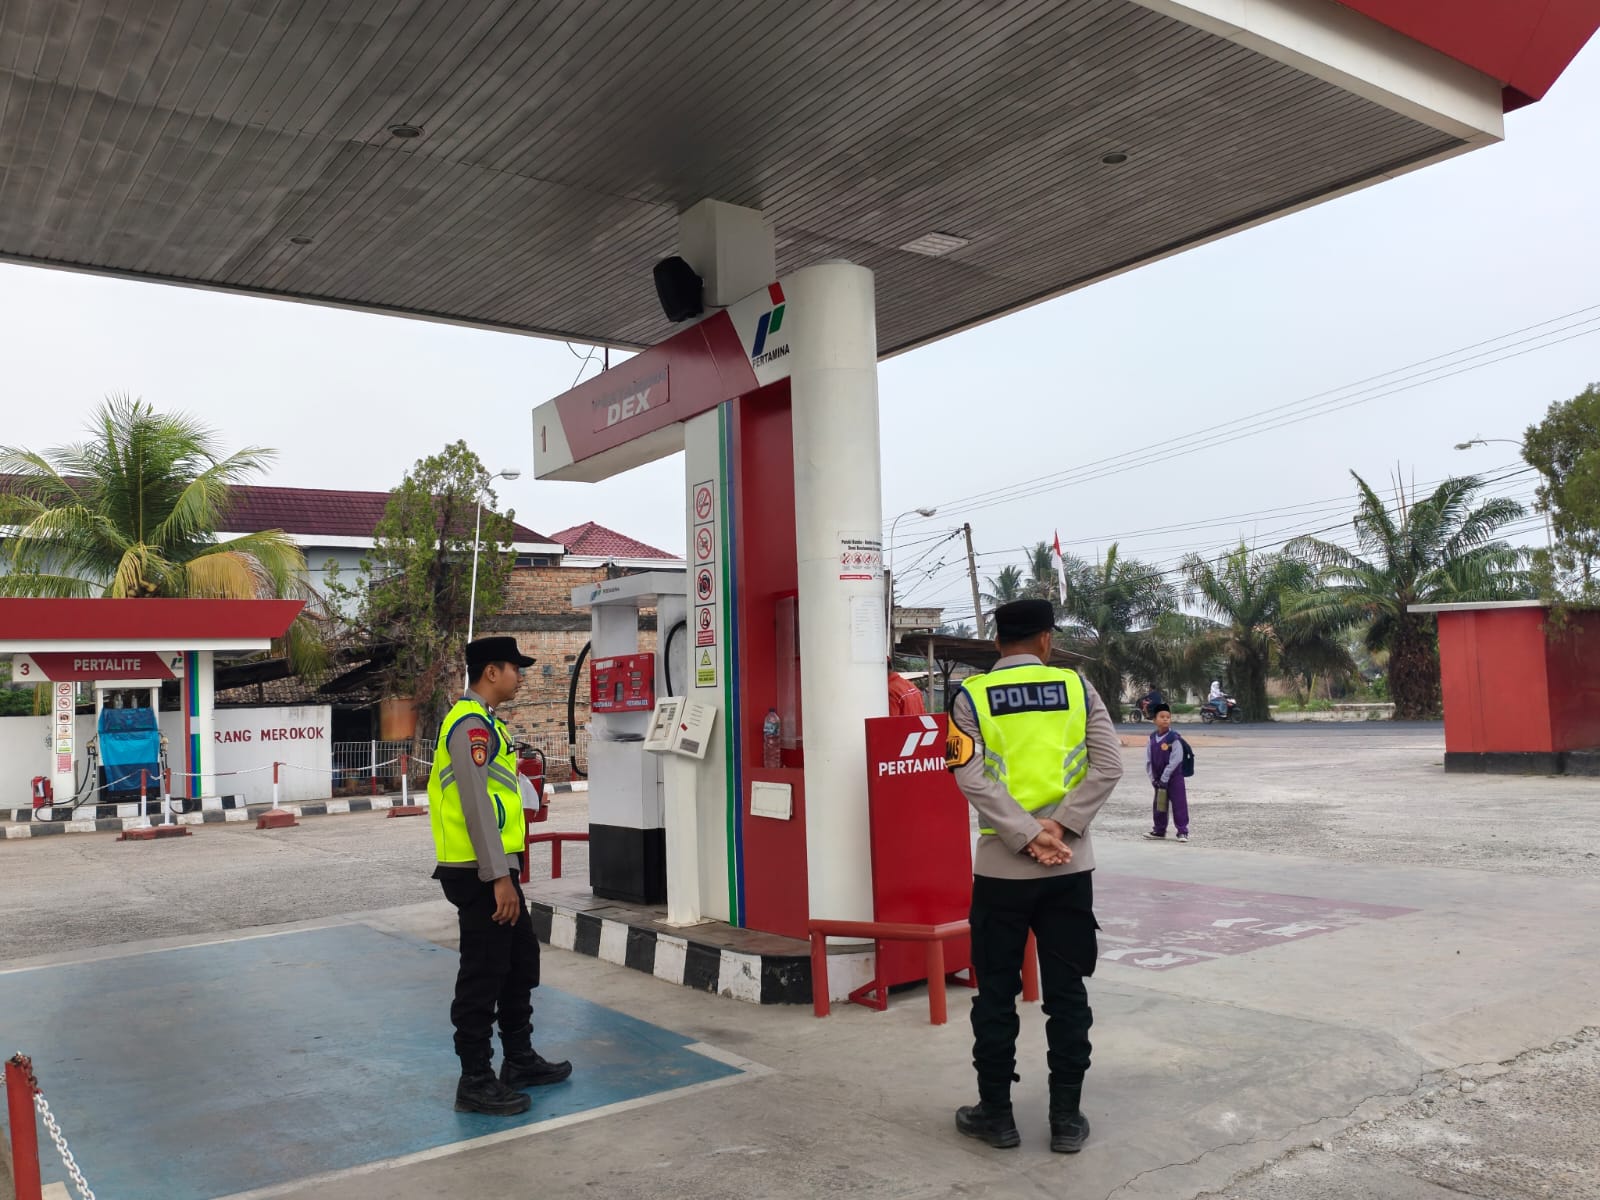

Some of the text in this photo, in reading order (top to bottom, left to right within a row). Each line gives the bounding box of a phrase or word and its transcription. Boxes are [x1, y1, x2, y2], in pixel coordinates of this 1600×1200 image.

[752, 343, 790, 369] PERTAMINA
[606, 387, 651, 426] DEX
[541, 425, 547, 453] 1
[20, 663, 30, 676] 3
[74, 658, 141, 671] PERTALITE
[990, 684, 1066, 710] POLISI
[260, 726, 324, 742] MEROKOK
[878, 756, 949, 777] PERTAMIN
